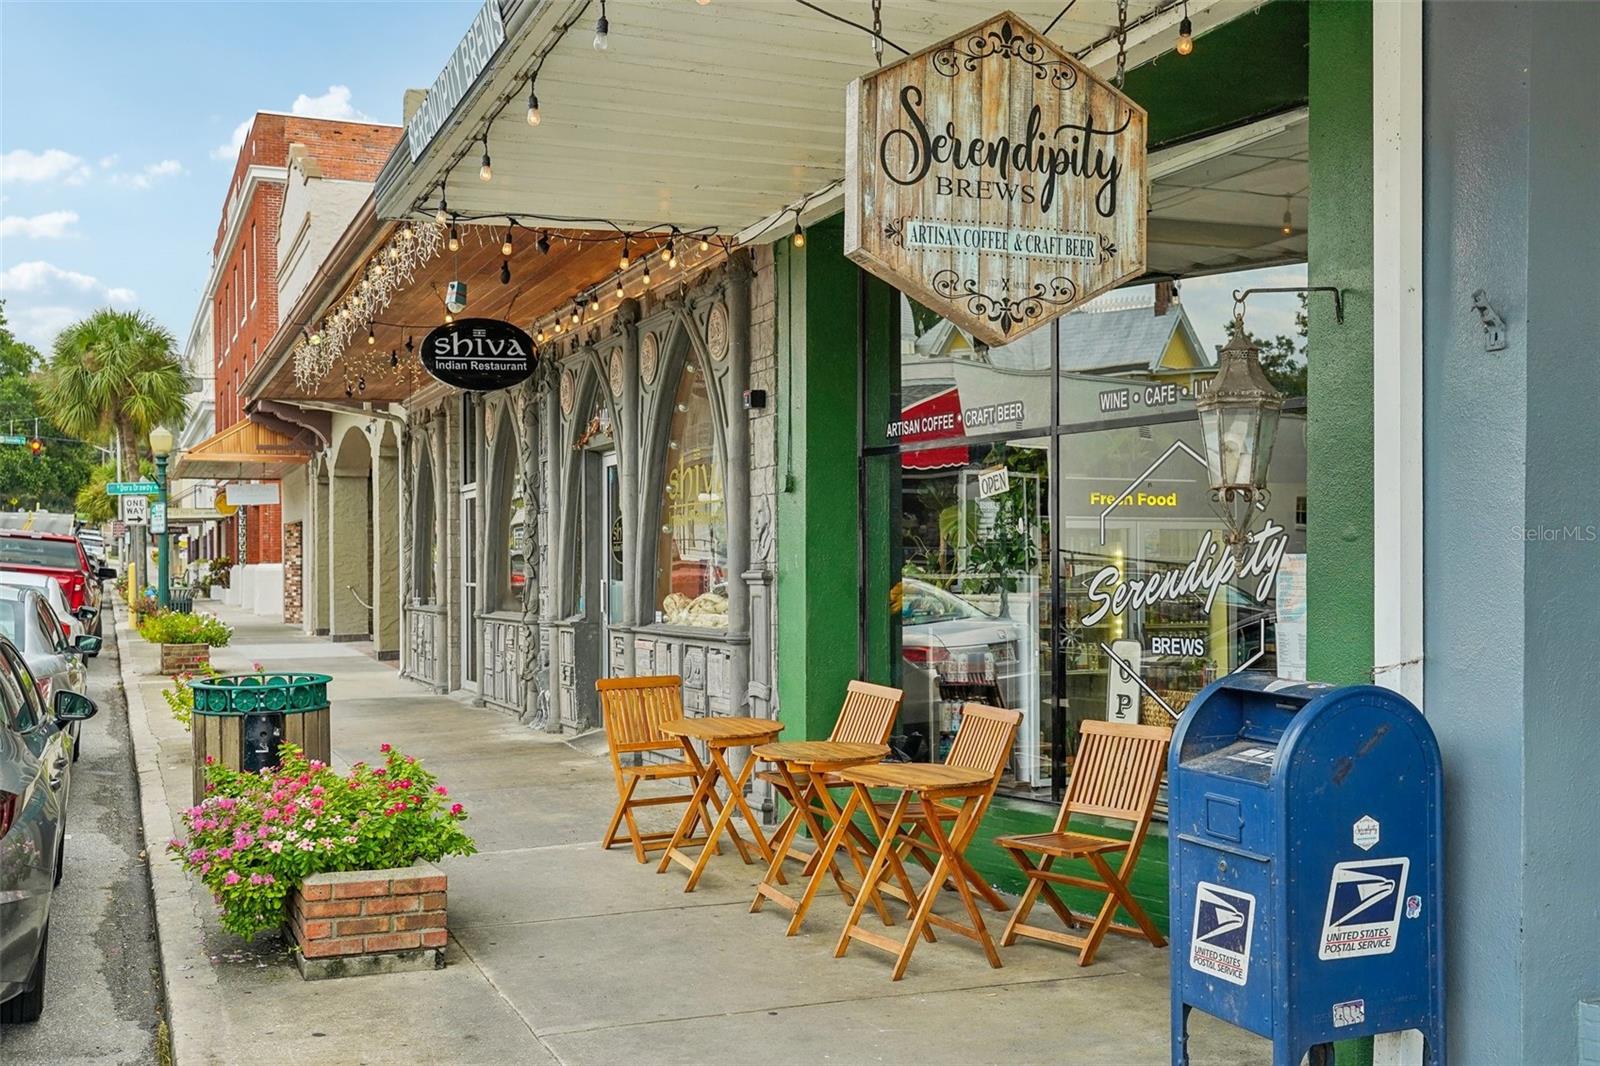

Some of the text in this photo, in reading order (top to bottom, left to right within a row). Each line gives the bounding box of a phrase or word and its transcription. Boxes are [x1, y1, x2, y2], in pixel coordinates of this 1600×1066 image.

[408, 0, 505, 163] SERENDIPITY BREWS
[880, 85, 1134, 217] Serendipity
[936, 176, 1035, 204] BREWS
[910, 224, 1095, 258] ARTISAN COFFEE & CRAFT BEER
[435, 329, 527, 357] shiva
[435, 360, 528, 371] Indian Restaurant
[1100, 390, 1128, 410] WINE
[1145, 385, 1176, 405] CAFE
[886, 402, 1023, 438] ARTISAN COFFEE CRAFT BEER
[981, 471, 1008, 495] OPEN
[126, 499, 144, 507] ONE
[1138, 492, 1176, 506] Food
[1152, 637, 1204, 656] BREWS
[1324, 938, 1391, 954] POSTAL SERVICE
[1326, 928, 1389, 942] UNITED STATES
[1193, 956, 1243, 979] POSTAL SERVICE
[1195, 945, 1241, 967] UNITED STATES
